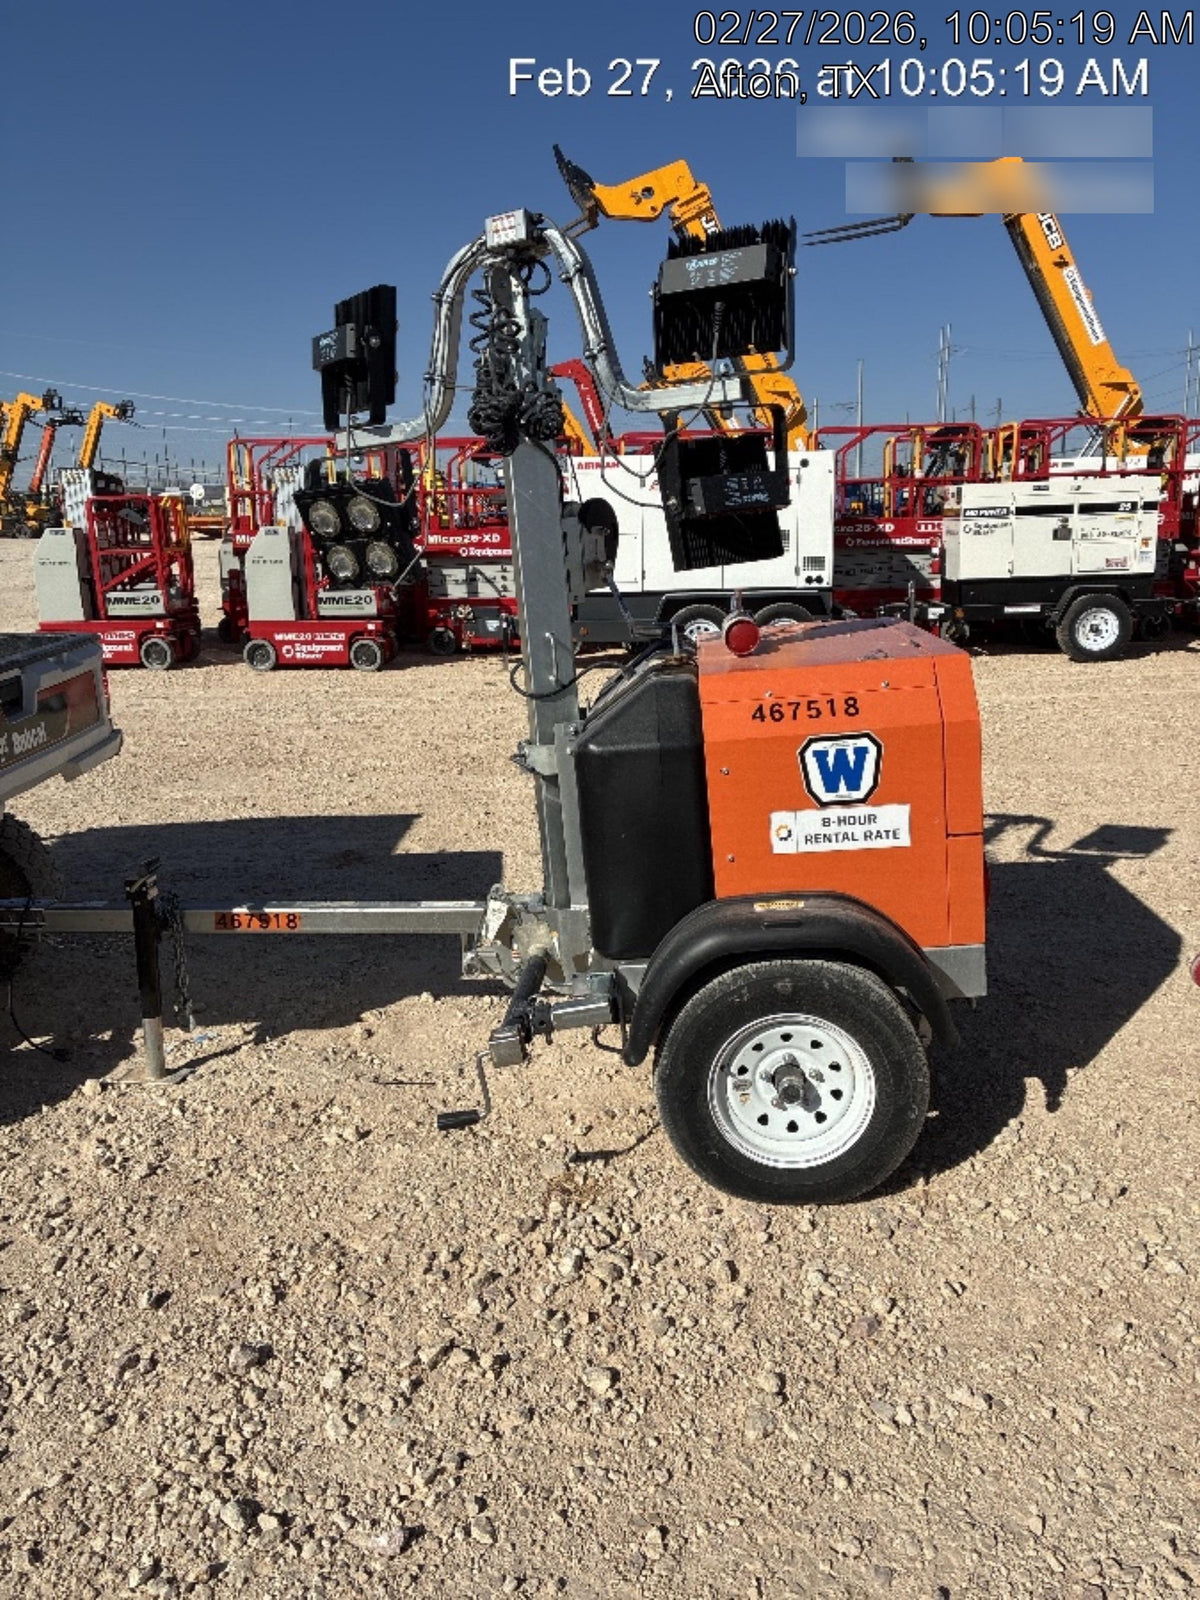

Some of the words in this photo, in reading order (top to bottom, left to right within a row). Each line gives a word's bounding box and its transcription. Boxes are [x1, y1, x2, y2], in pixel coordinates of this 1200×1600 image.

[317, 595, 372, 605] MME20
[751, 696, 861, 723] 467518
[812, 746, 869, 794] W
[821, 814, 878, 828] 8-HOUR
[804, 832, 860, 846] RENTAL
[863, 829, 902, 842] RATE
[215, 913, 298, 930] 467518
